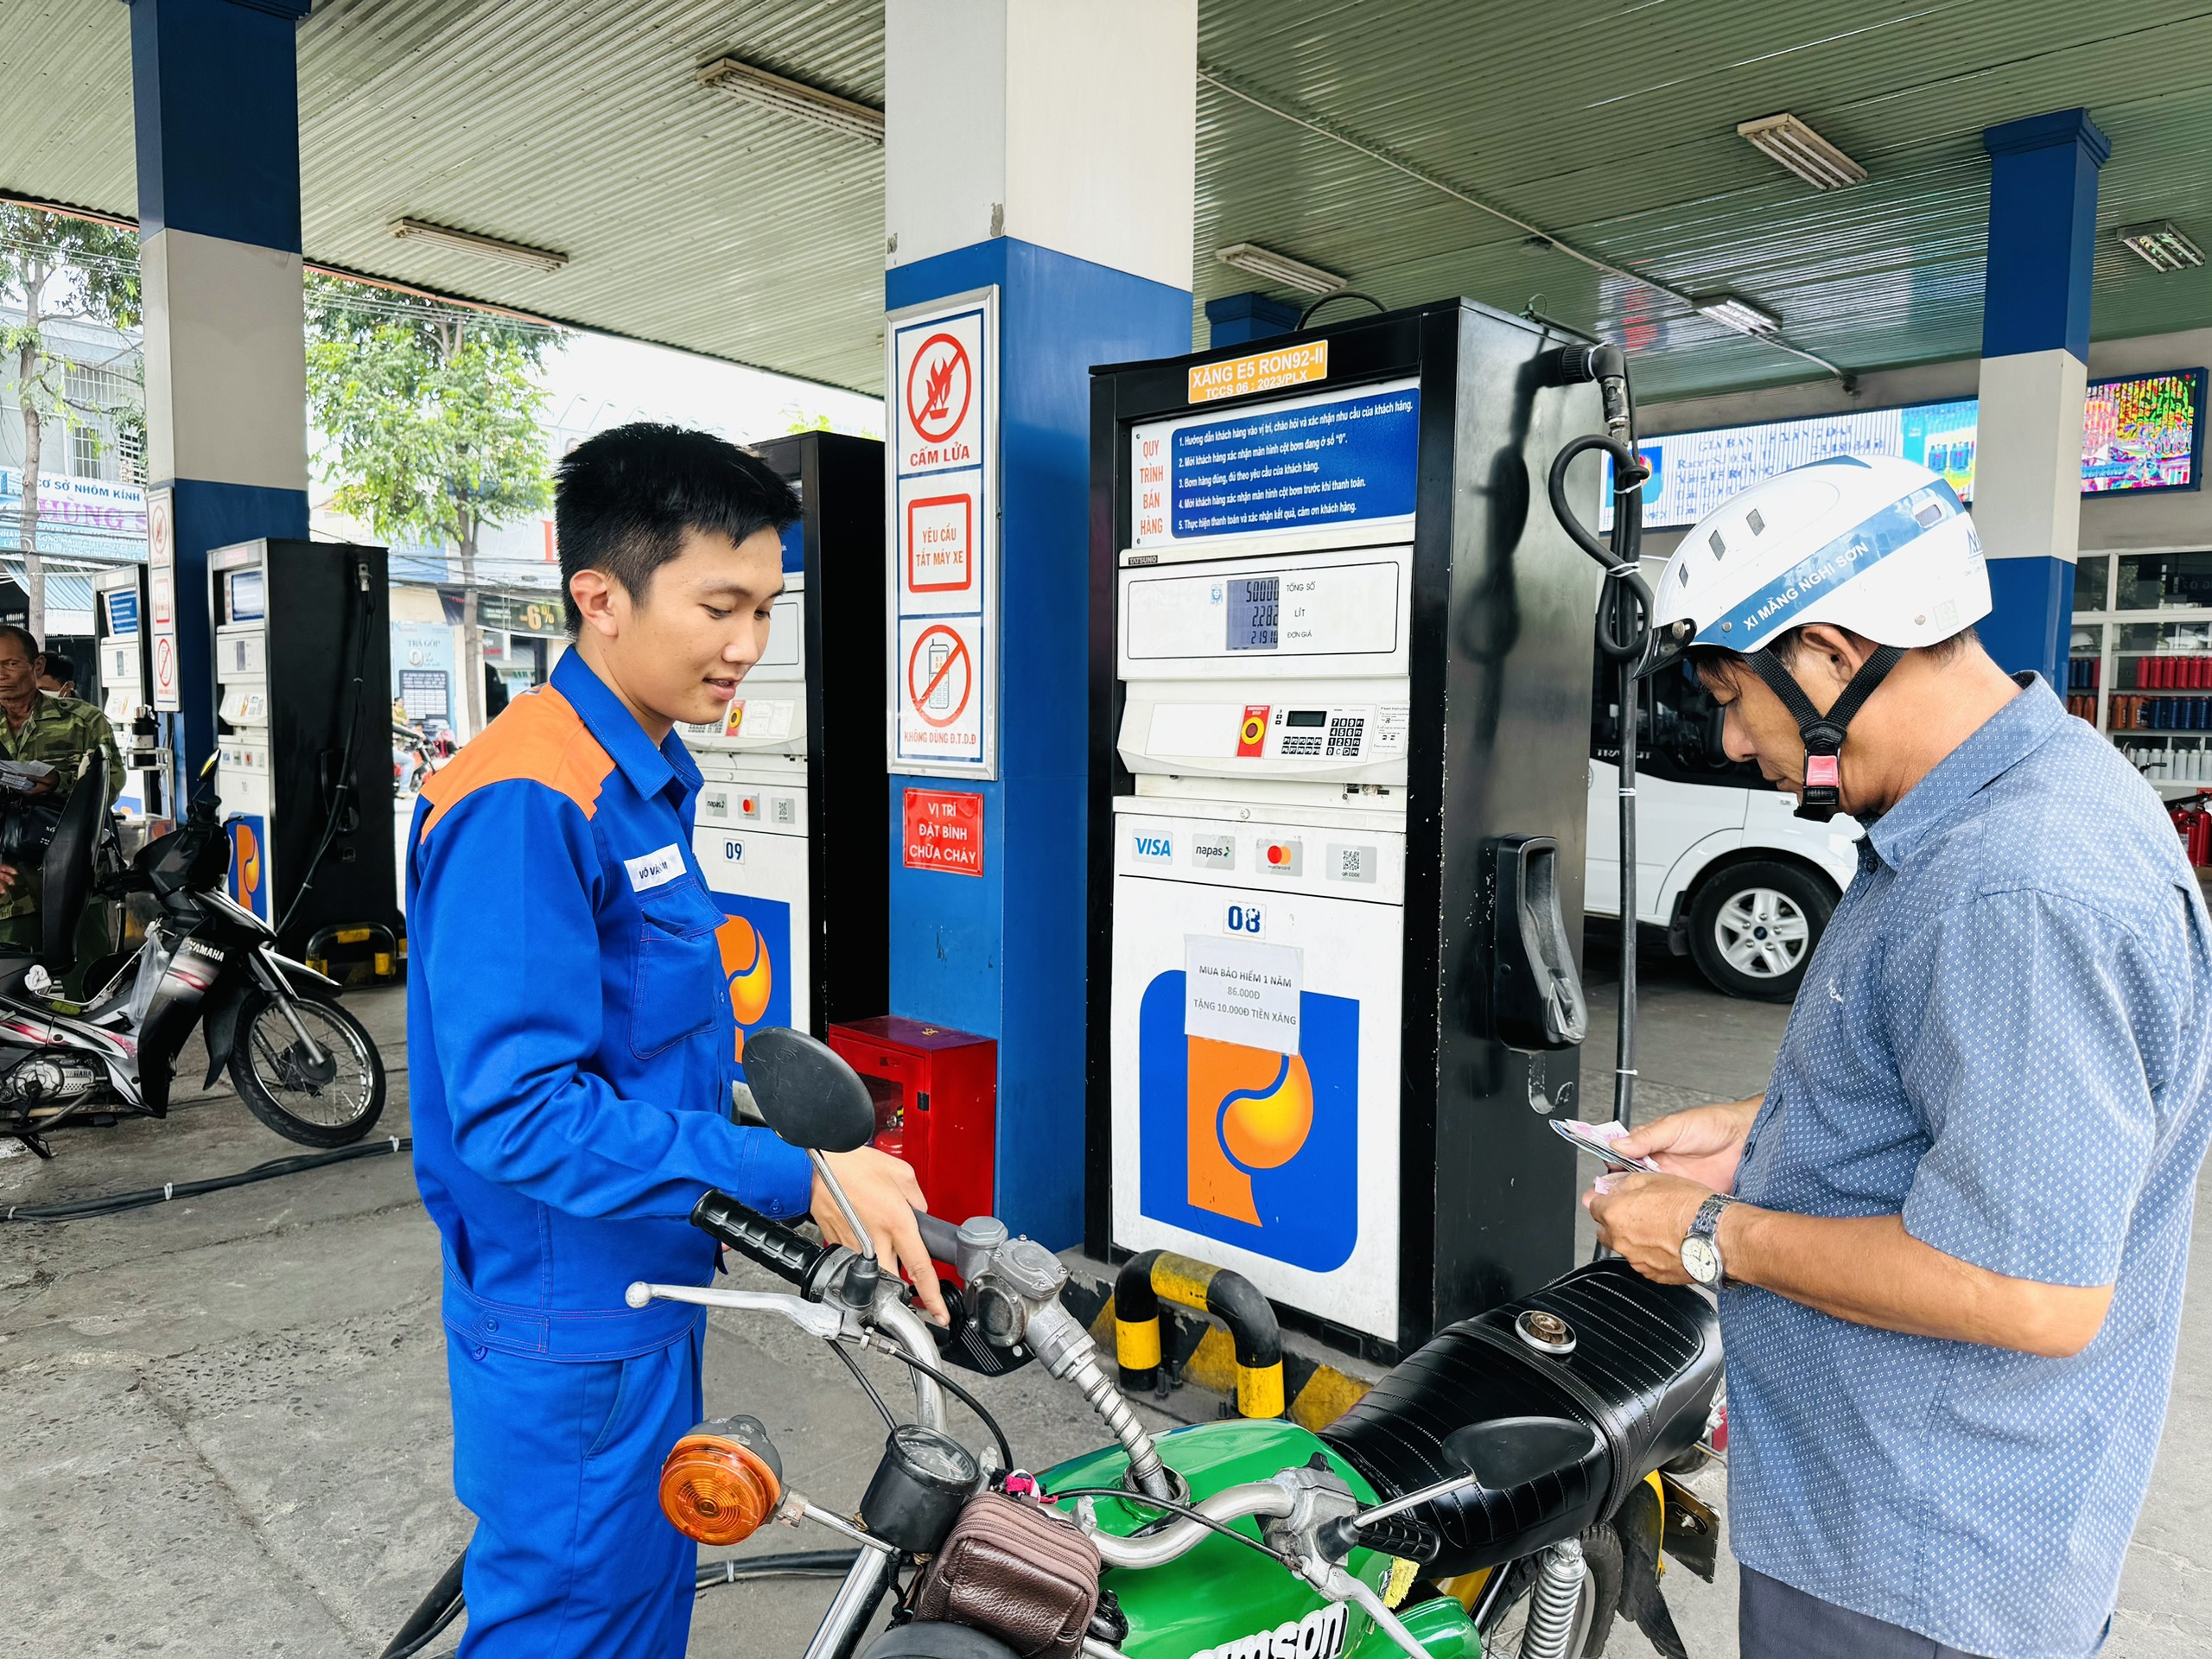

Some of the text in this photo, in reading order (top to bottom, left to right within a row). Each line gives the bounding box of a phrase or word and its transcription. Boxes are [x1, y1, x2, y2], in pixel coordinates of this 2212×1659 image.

[1193, 346, 1323, 388] XĂNG E5 RON92-II
[1205, 385, 1233, 398] TCCS
[1237, 384, 1249, 392] 06
[1258, 370, 1307, 389] 2023/PLX
[1215, 431, 1231, 441] khách
[1232, 429, 1246, 440] hàng
[1248, 425, 1257, 436] vào
[1274, 421, 1288, 431] chào
[1300, 416, 1307, 427] và
[1308, 414, 1319, 426] xác
[1320, 413, 1334, 425] nhận
[1336, 410, 1348, 421] nhu
[1350, 406, 1360, 419] cầu
[1362, 406, 1373, 417] của
[1375, 400, 1394, 416] khách
[1395, 400, 1413, 413] hàng.
[911, 442, 970, 467] CẤM LỬA
[1143, 440, 1160, 460] QUY
[1196, 453, 1211, 465] khách
[1213, 452, 1226, 464] hàng
[1227, 448, 1236, 461] xác
[1238, 448, 1251, 461] nhận
[1253, 446, 1265, 456] màn
[1266, 444, 1278, 454] hình
[1280, 442, 1288, 454] cột
[1305, 439, 1319, 450] đang
[1327, 433, 1334, 446] số
[1140, 463, 1163, 484] TRÌNH
[1198, 476, 1211, 487] hàng
[1237, 470, 1249, 480] theo
[1250, 468, 1261, 481] yêu
[1262, 466, 1272, 477] cầu
[1273, 465, 1283, 475] của
[1285, 461, 1302, 474] khách
[1303, 461, 1319, 473] hàng.
[54, 480, 70, 491] SỞ
[74, 483, 109, 498] NHÔM
[113, 489, 140, 501] KÍNH
[1143, 488, 1160, 510] BÁN
[1196, 496, 1211, 506] khách
[1212, 495, 1226, 506] hàng
[1227, 493, 1236, 503] xác
[1237, 492, 1251, 504] nhận
[1252, 490, 1264, 500] màn
[1266, 488, 1278, 499] hình
[1279, 486, 1288, 498] cột
[1304, 484, 1320, 494] trước
[1322, 481, 1331, 492] khi
[1332, 479, 1349, 491] thanh
[1351, 477, 1365, 488] toán.
[1141, 515, 1163, 536] HÀNG
[1199, 518, 1210, 529] hiện
[1211, 517, 1226, 526] thanh
[1227, 515, 1239, 524] toán
[1241, 514, 1248, 524] và
[1249, 512, 1258, 522] xác
[1259, 511, 1273, 524] nhận
[1274, 507, 1283, 519] kết
[1298, 506, 1310, 517] cảm
[1320, 503, 1338, 514] khách
[1340, 501, 1357, 513] hàng.
[923, 523, 957, 543] YÊU CẦU
[916, 548, 963, 567] TẮT MÁY XE
[1129, 556, 1156, 565] TATSUNO
[1287, 582, 1316, 592] TỔNG SỐ
[1743, 615, 1758, 632] XI
[1798, 563, 1836, 593] NGHI
[1835, 541, 1869, 568] SƠN
[520, 604, 555, 630] -6%
[1295, 607, 1306, 617] LÍT
[904, 728, 927, 742] KHÔNG
[930, 729, 948, 743] DÙNG
[928, 802, 957, 817] VỊ TRÍ
[919, 821, 967, 841] ĐẶT BÌNH
[726, 842, 742, 861] 09
[910, 843, 976, 864] CHỮA CHÁY
[1134, 837, 1171, 857] VISA
[1196, 846, 1223, 858] napas
[1228, 906, 1261, 932] 08
[190, 941, 224, 962] YAMAHA
[1199, 965, 1218, 976] MUA
[1220, 967, 1237, 979] BẢO
[1270, 976, 1292, 988] NĂM
[1227, 987, 1260, 1000] 86.000Đ
[1194, 999, 1296, 1025] TẶNG 10.000Đ TIỀN XĂNG
[1188, 1601, 1349, 1659] mson
